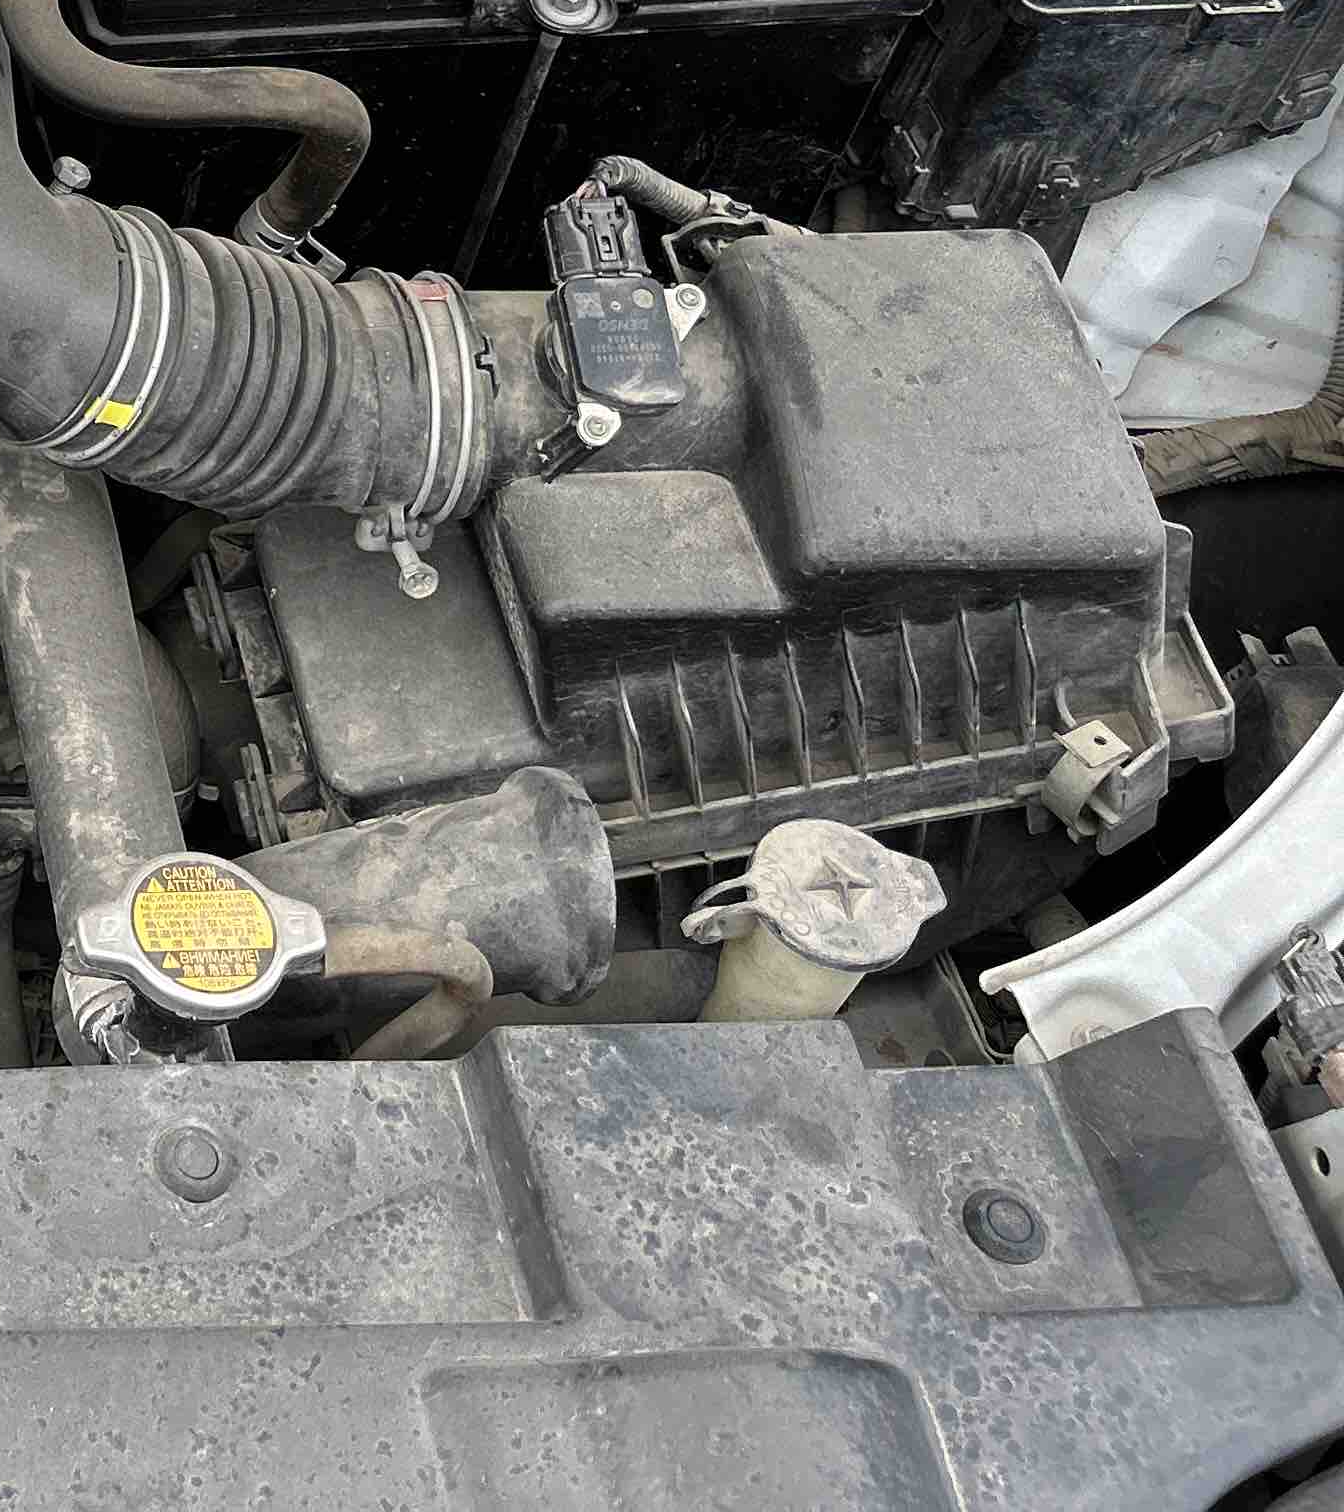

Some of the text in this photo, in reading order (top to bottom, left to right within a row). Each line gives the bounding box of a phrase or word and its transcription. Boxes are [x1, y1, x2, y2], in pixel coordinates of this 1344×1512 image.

[598, 318, 649, 332] DENSO
[162, 866, 216, 881] CAUTION
[166, 878, 236, 892] ATTENTION
[143, 894, 174, 903] NEVER
[176, 893, 201, 902] OPEN
